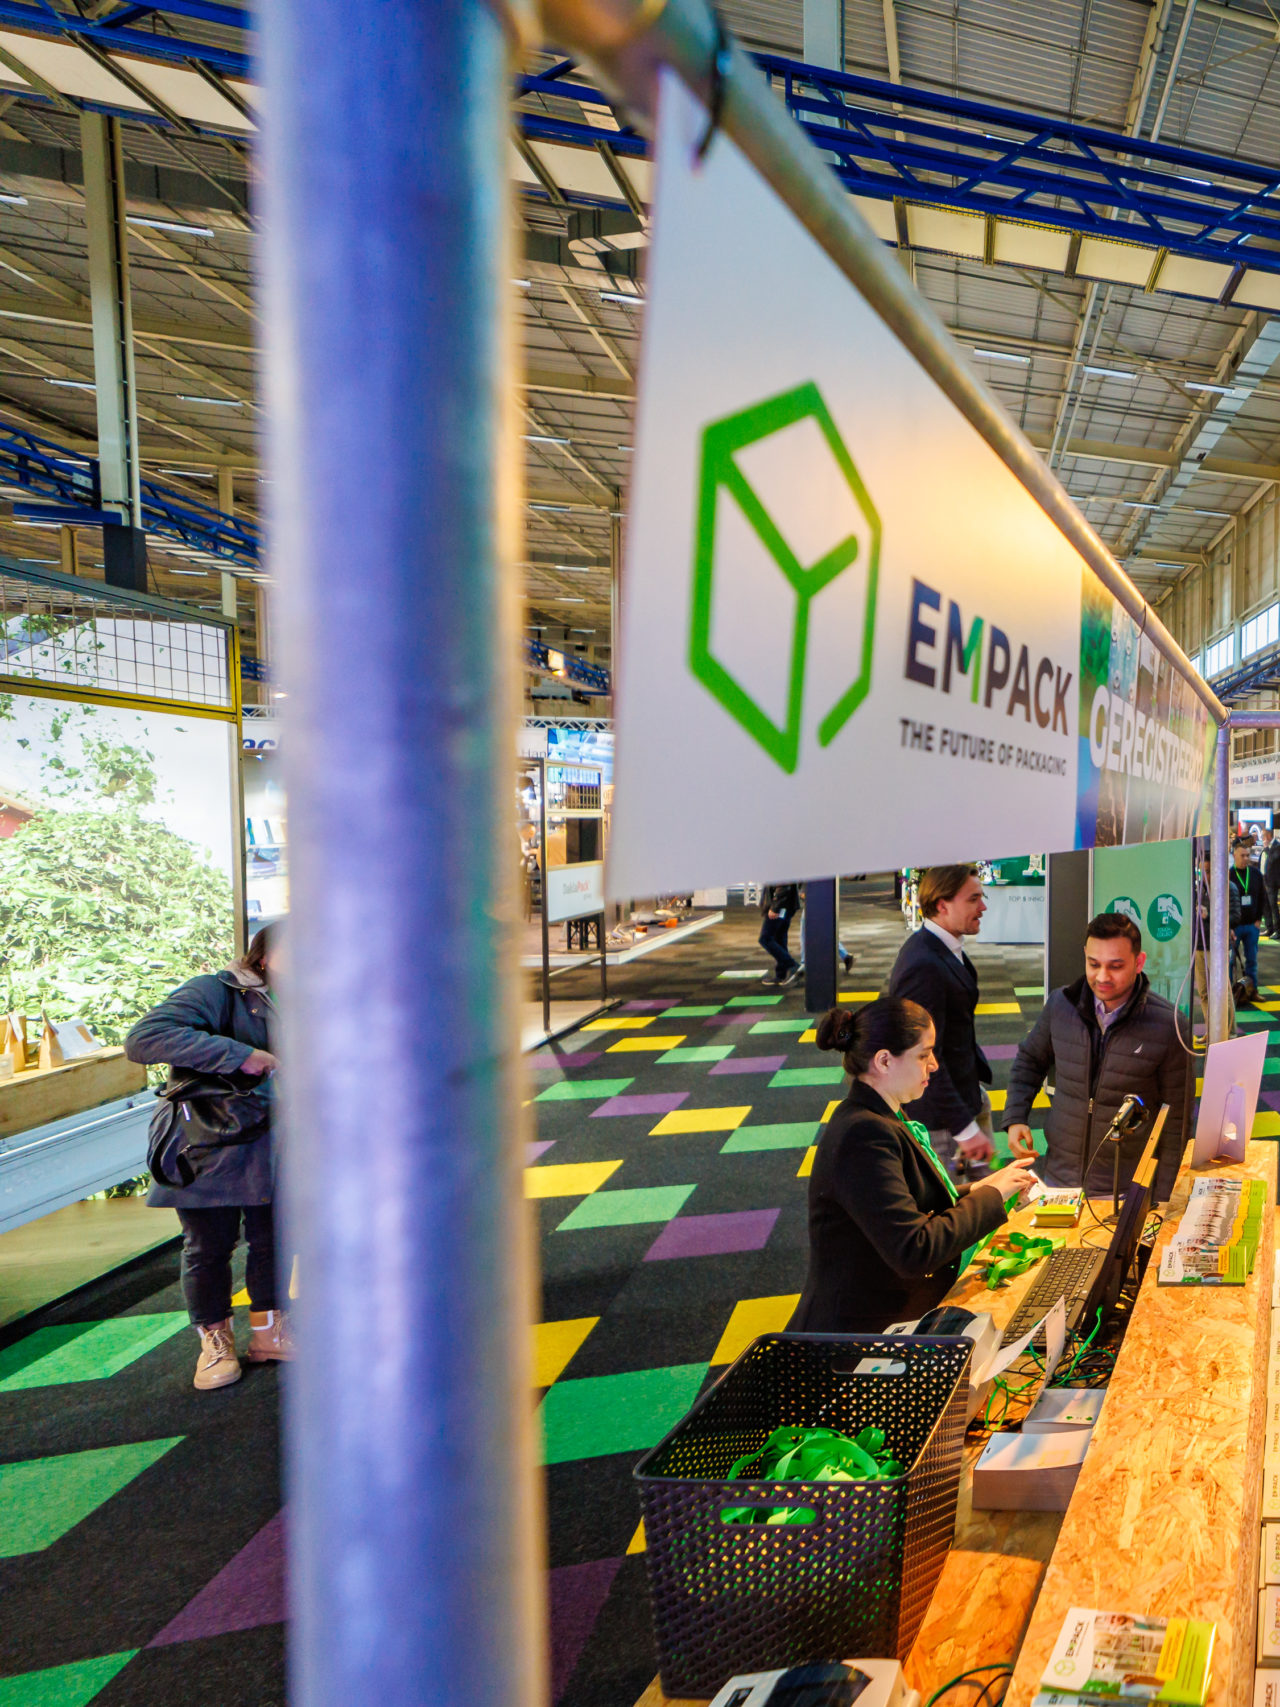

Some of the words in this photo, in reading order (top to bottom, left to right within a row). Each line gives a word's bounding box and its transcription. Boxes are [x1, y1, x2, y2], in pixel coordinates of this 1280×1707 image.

[904, 576, 1073, 737] EMPACK
[900, 716, 935, 753] THE
[939, 727, 995, 764] FUTURE
[997, 742, 1014, 768] OF
[1014, 748, 1067, 777] PACKAGING
